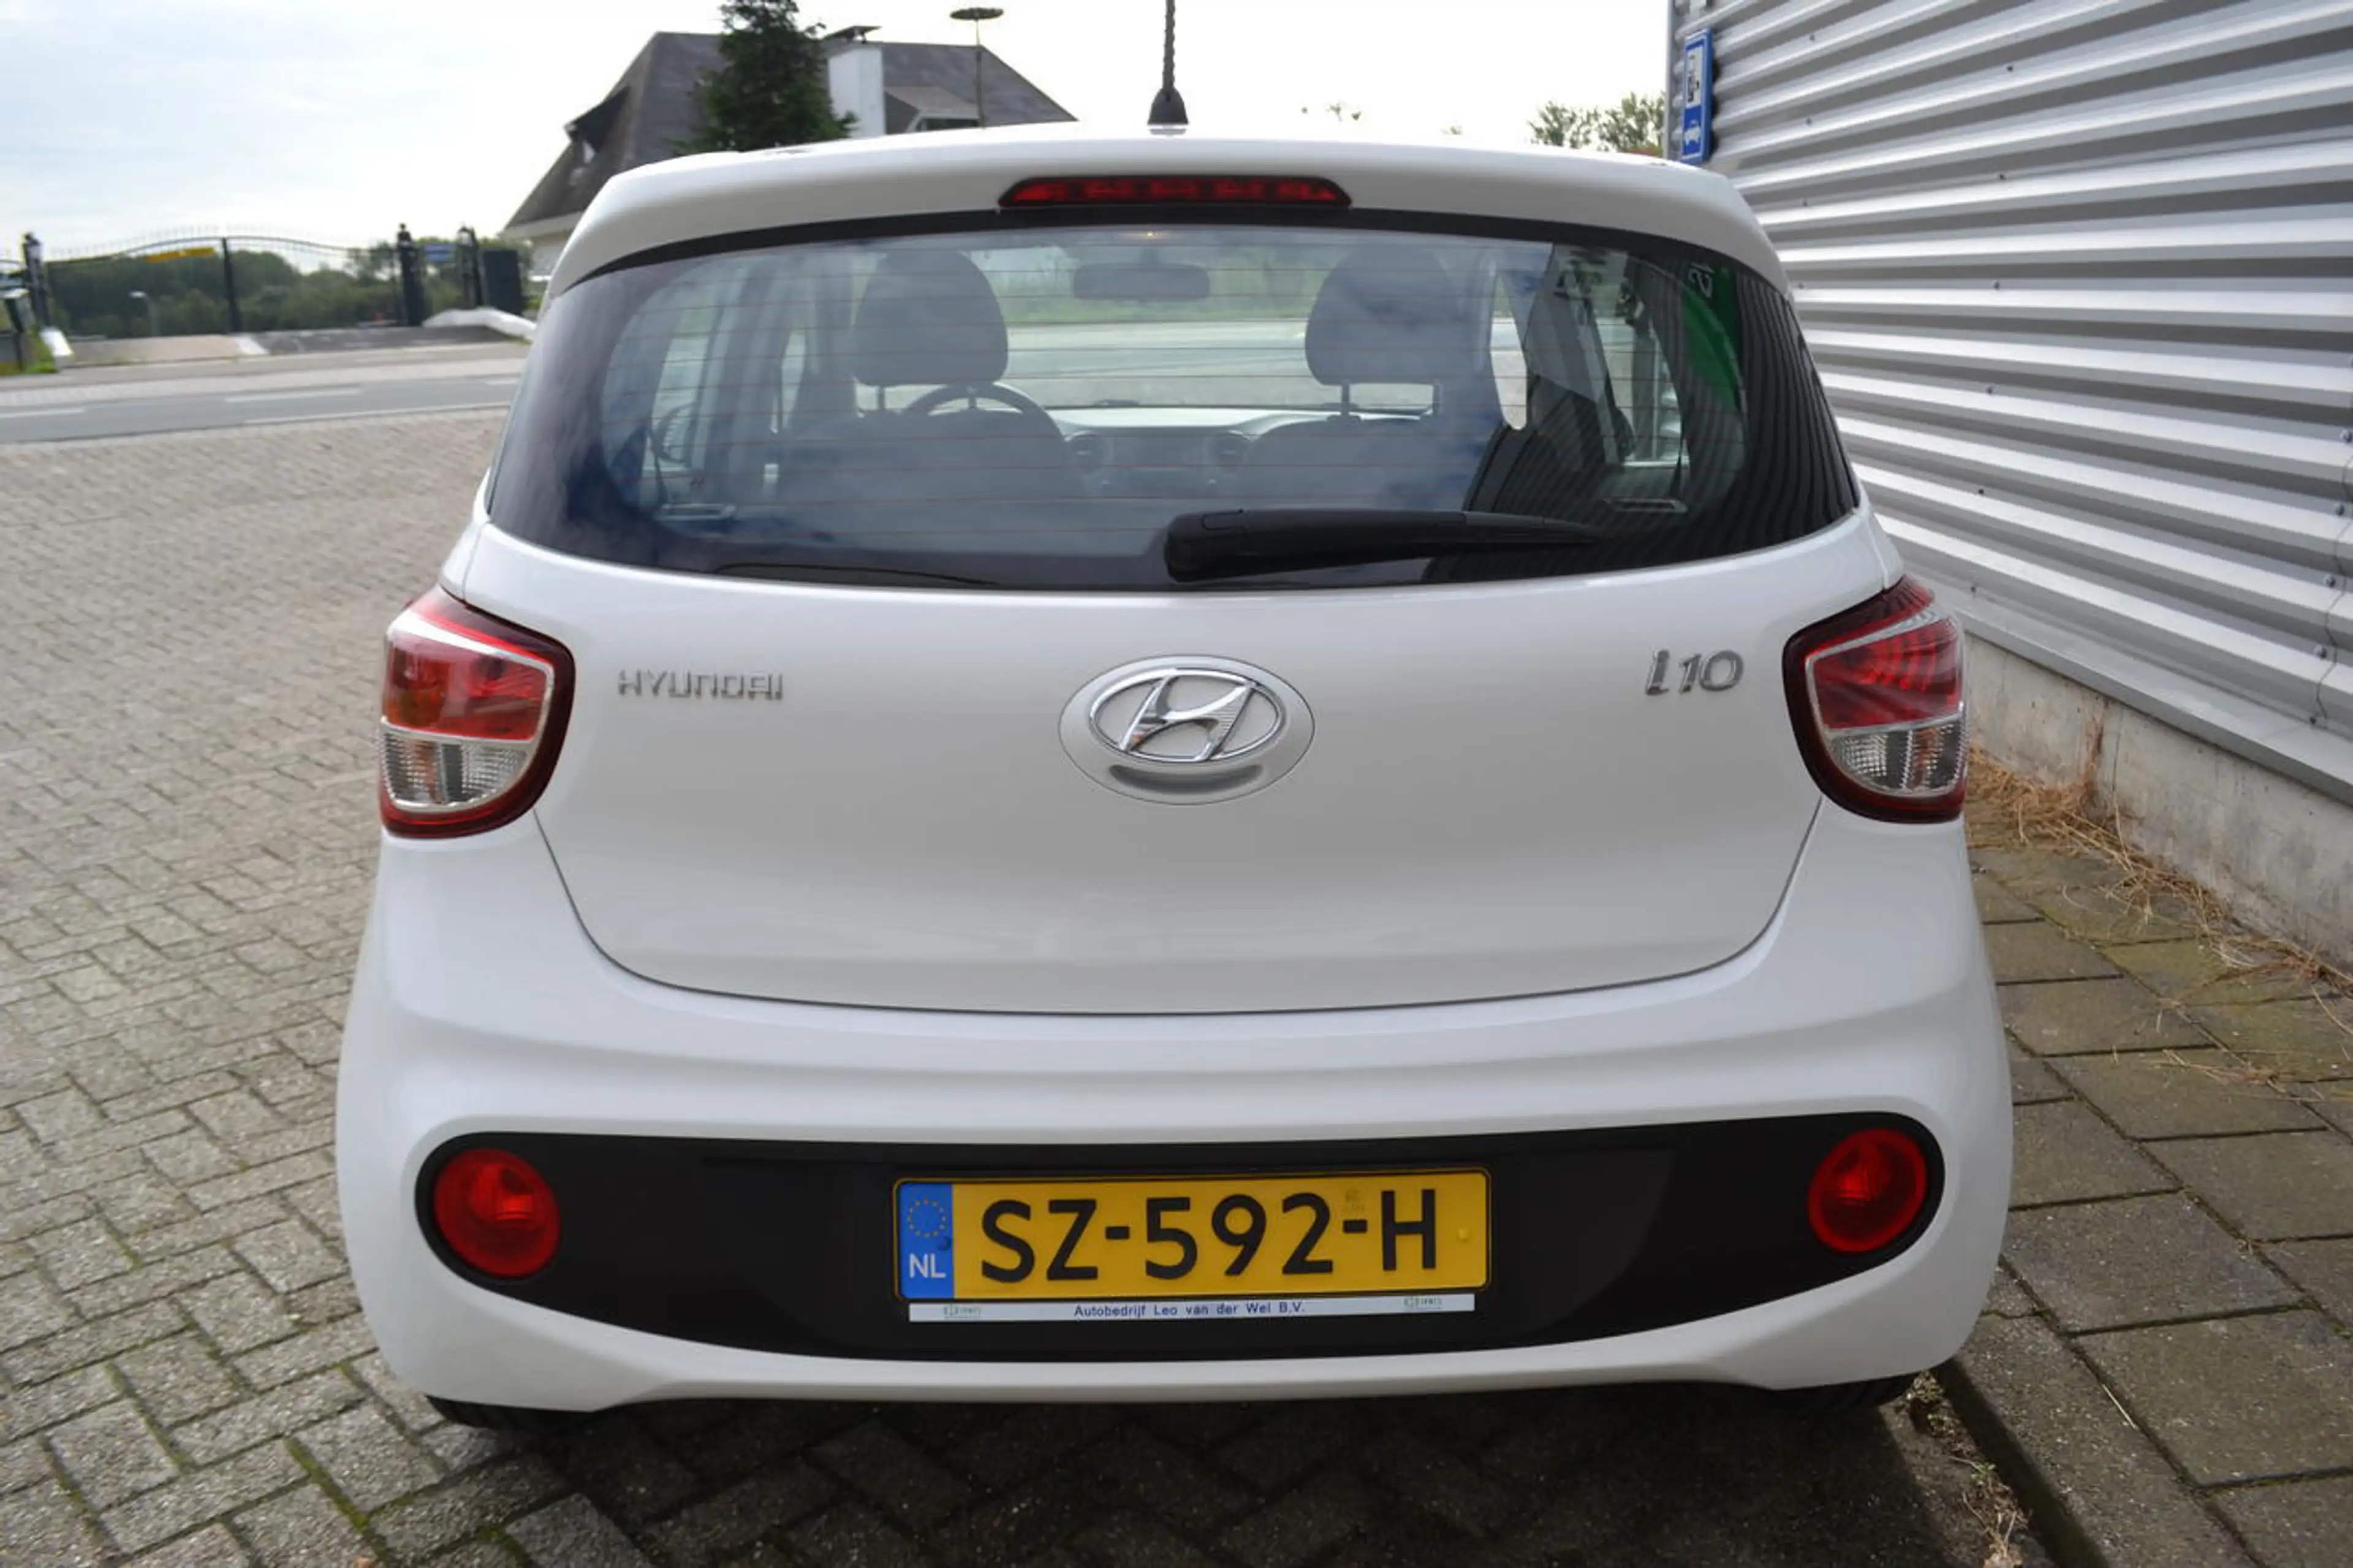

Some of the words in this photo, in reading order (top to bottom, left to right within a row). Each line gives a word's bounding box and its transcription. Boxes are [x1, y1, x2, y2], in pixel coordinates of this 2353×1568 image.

[618, 669, 783, 701] HYUNDAI
[981, 1189, 1437, 1284] SZ-592-H
[909, 1254, 947, 1279] NL
[1074, 1305, 1146, 1317] Autobedrijf
[1154, 1304, 1178, 1316] Leo
[1185, 1305, 1209, 1315] van
[1216, 1302, 1237, 1315] der
[1279, 1301, 1306, 1314] B.V.
